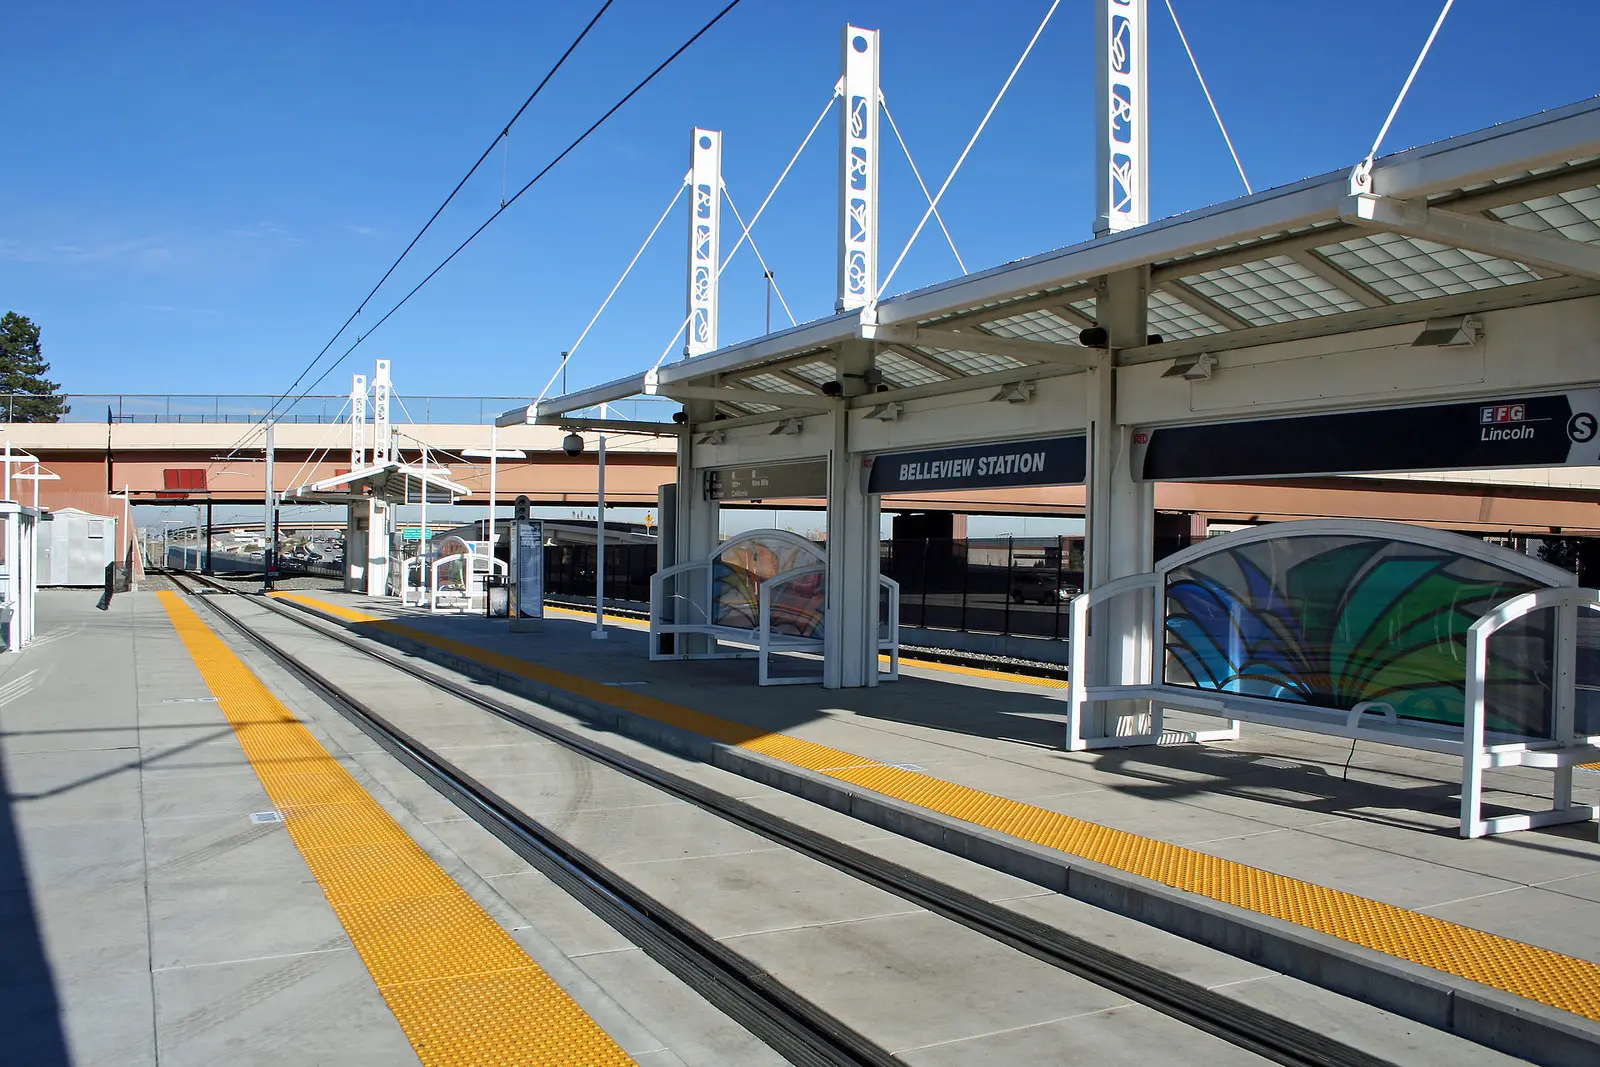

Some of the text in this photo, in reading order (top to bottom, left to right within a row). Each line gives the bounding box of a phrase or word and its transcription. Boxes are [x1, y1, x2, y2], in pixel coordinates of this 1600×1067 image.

[1481, 424, 1534, 442] Lincoln
[1572, 416, 1593, 440] S
[899, 452, 1046, 481] BELLEVIEW STATION
